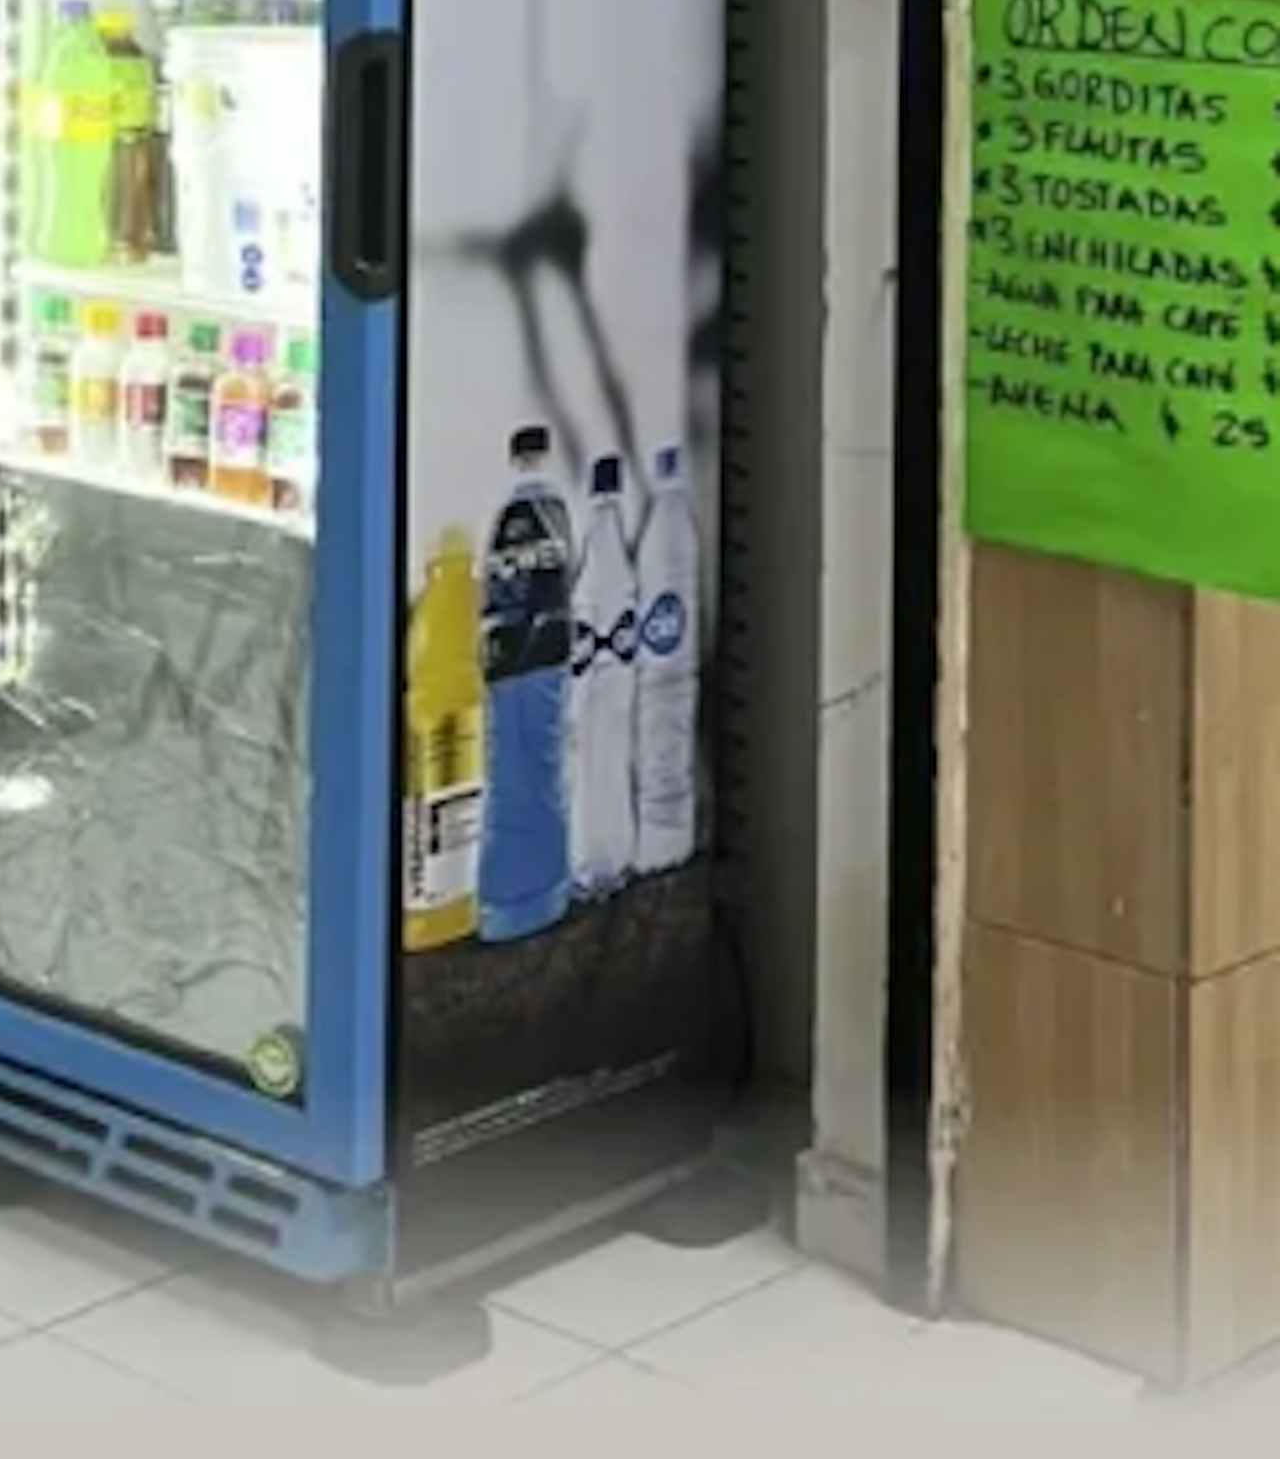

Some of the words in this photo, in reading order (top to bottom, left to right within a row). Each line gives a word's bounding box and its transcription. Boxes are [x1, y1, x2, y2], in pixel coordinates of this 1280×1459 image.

[998, 58, 1024, 102] 3
[1033, 64, 1230, 126] GORDITAS
[1002, 114, 1036, 155] 3
[1043, 120, 1209, 174] FLAUTAS
[999, 162, 1024, 207] 3
[1029, 172, 1229, 228] TOSTADAS
[991, 213, 1017, 258] 3
